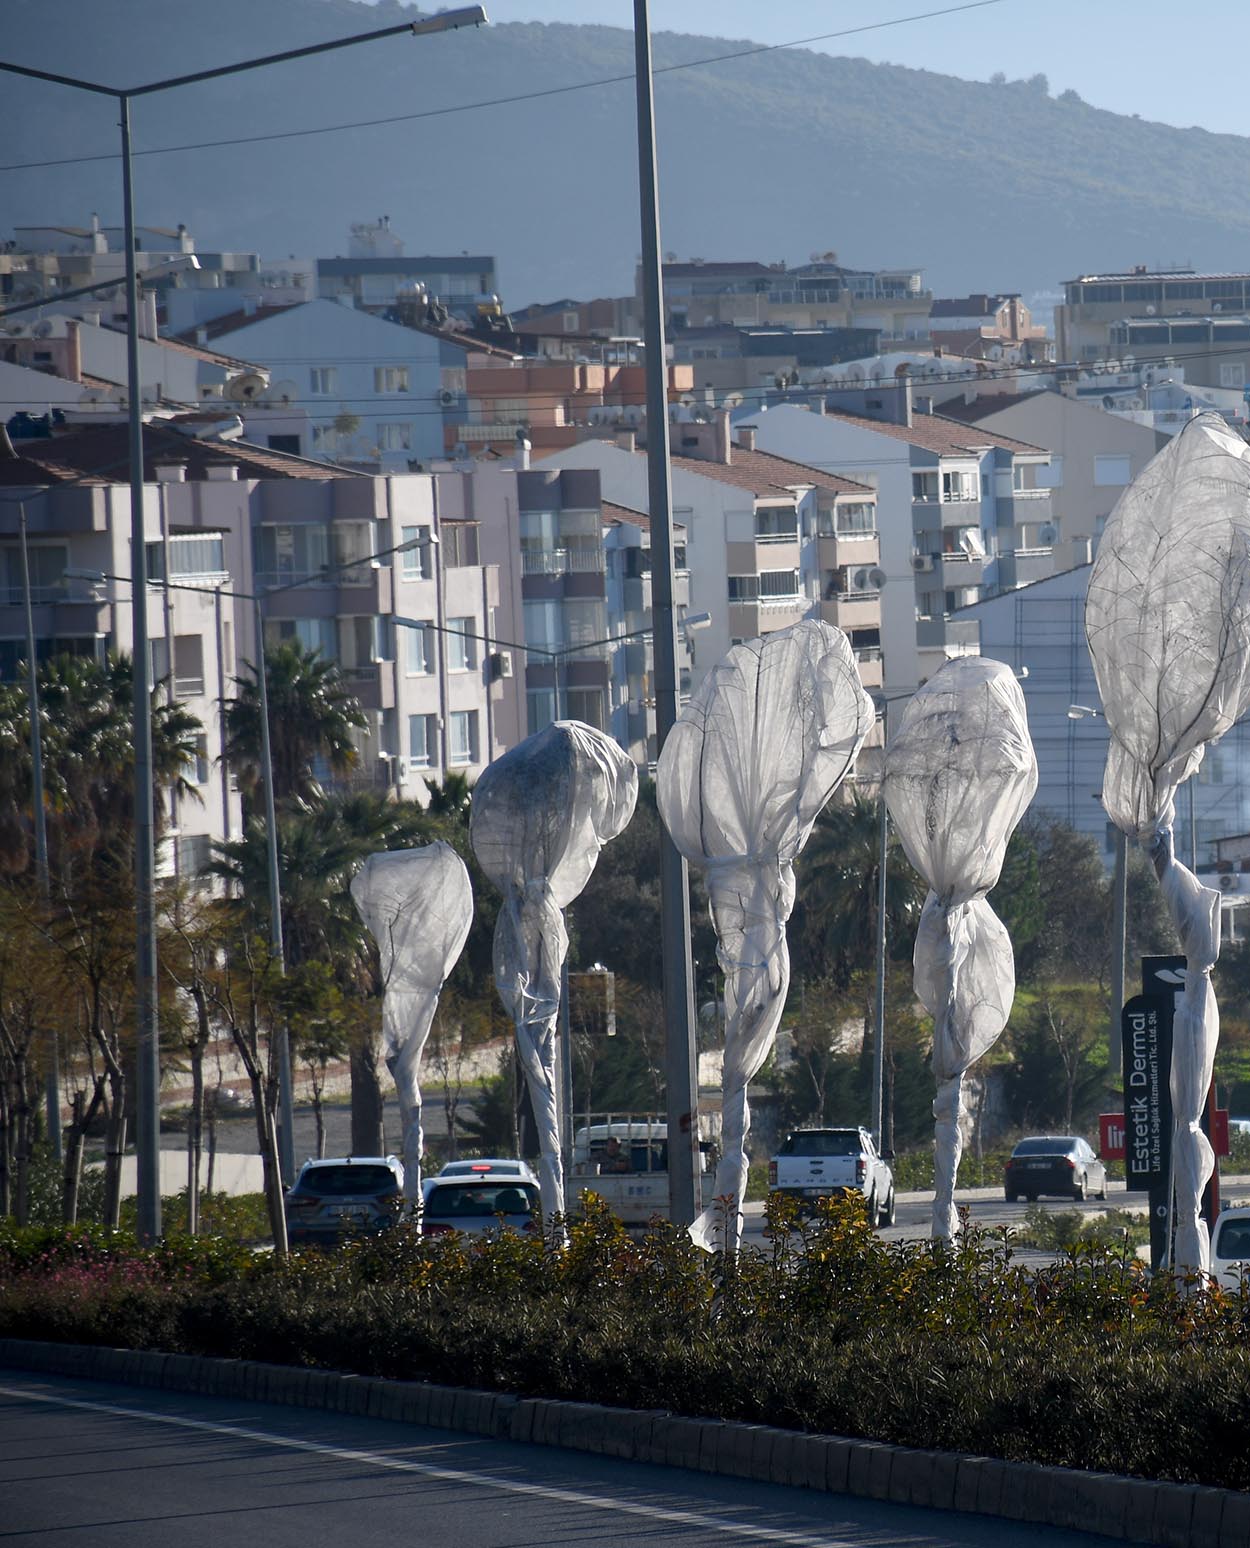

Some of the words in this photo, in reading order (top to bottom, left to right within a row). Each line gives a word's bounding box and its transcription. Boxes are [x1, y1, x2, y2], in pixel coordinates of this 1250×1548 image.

[1128, 1013, 1147, 1086] Dermal
[1150, 1061, 1160, 1106] Hizmetleri
[1130, 1096, 1150, 1173] Estetik
